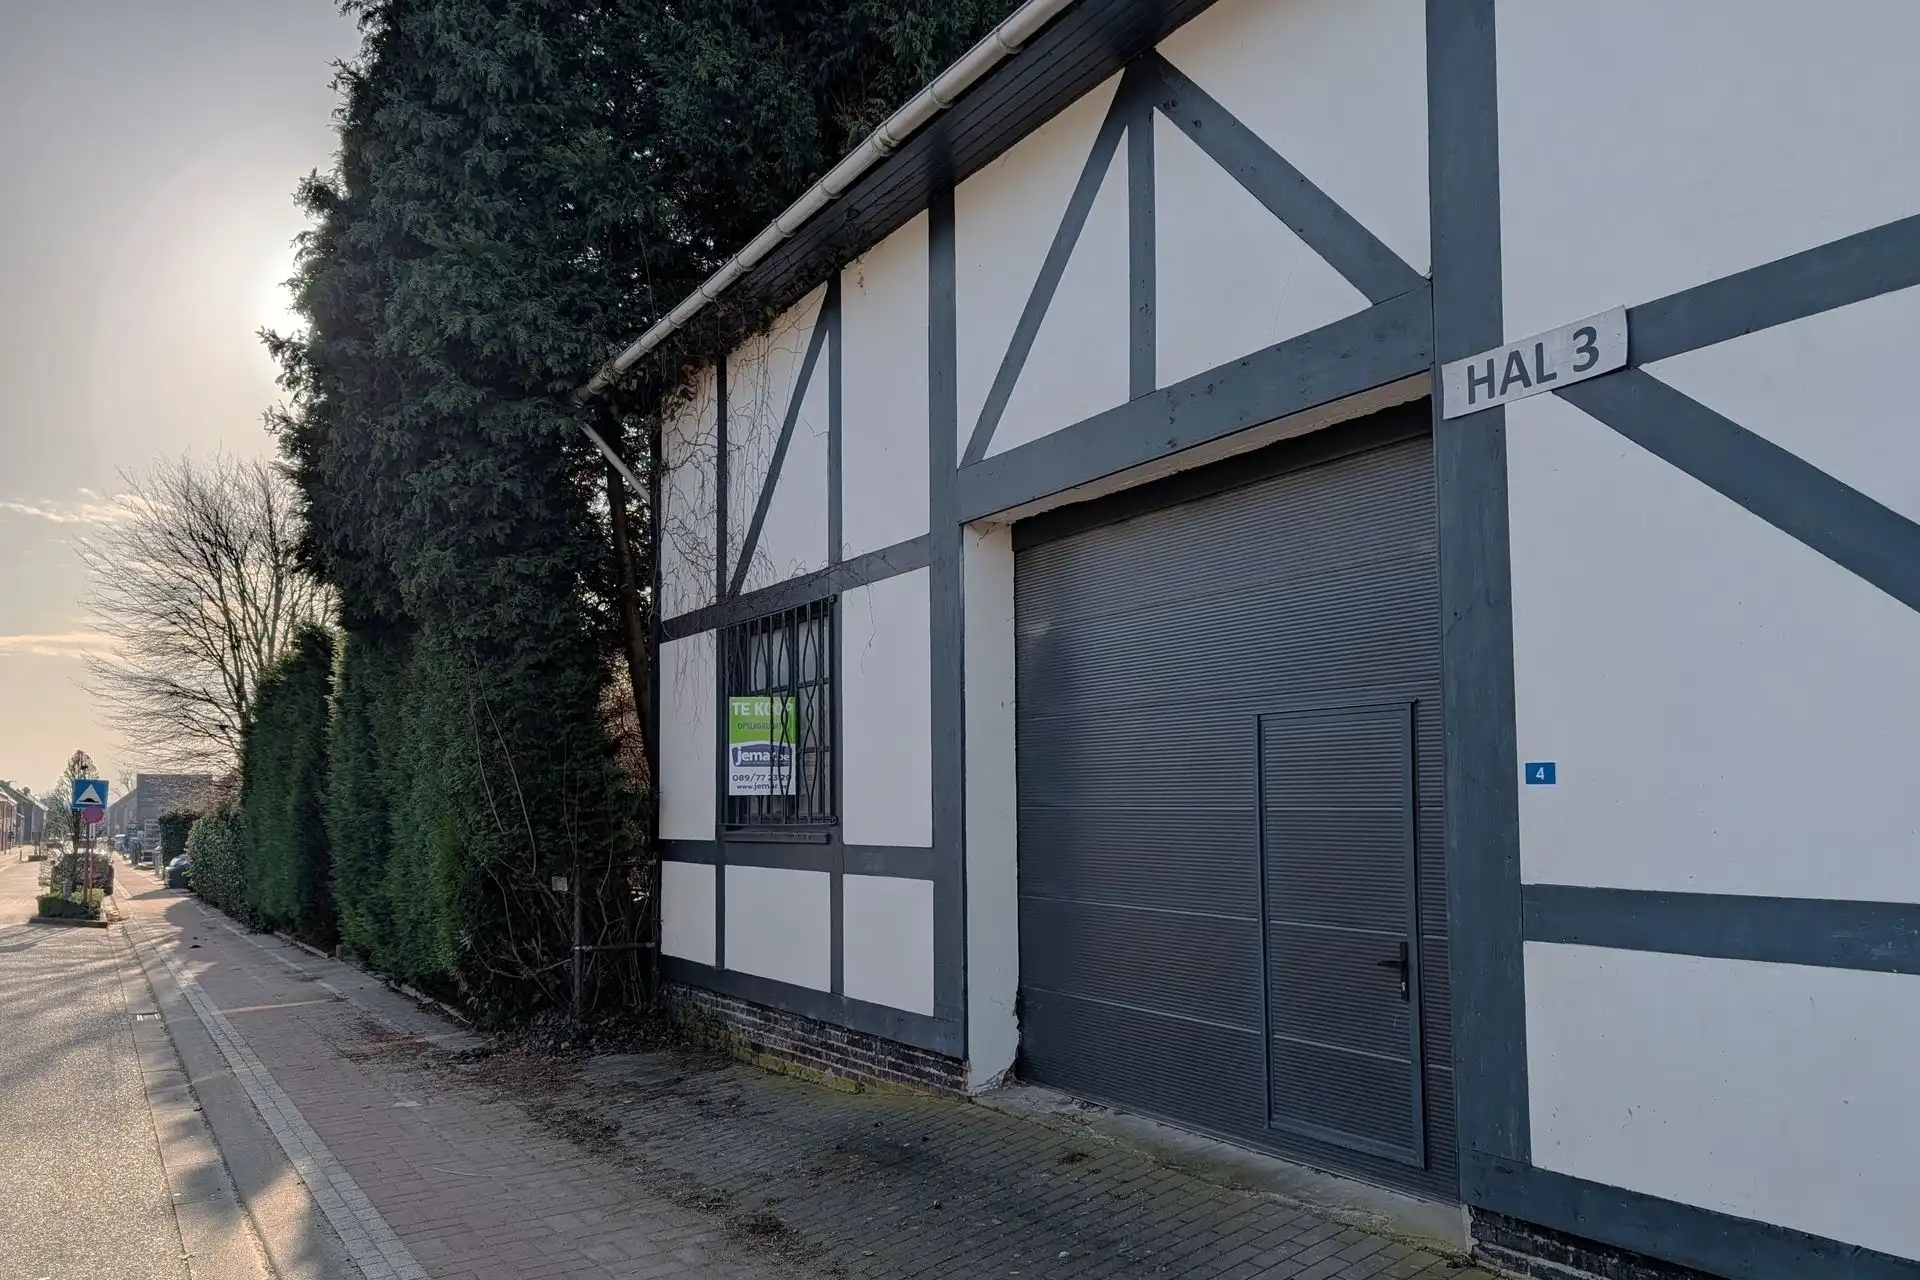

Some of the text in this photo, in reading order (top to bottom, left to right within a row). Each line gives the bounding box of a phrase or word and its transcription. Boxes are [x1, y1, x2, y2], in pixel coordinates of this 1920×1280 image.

[1467, 327, 1599, 405] HAL 3
[732, 702, 750, 716] TE
[732, 773, 766, 782] 089/77
[1535, 766, 1545, 780] 4
